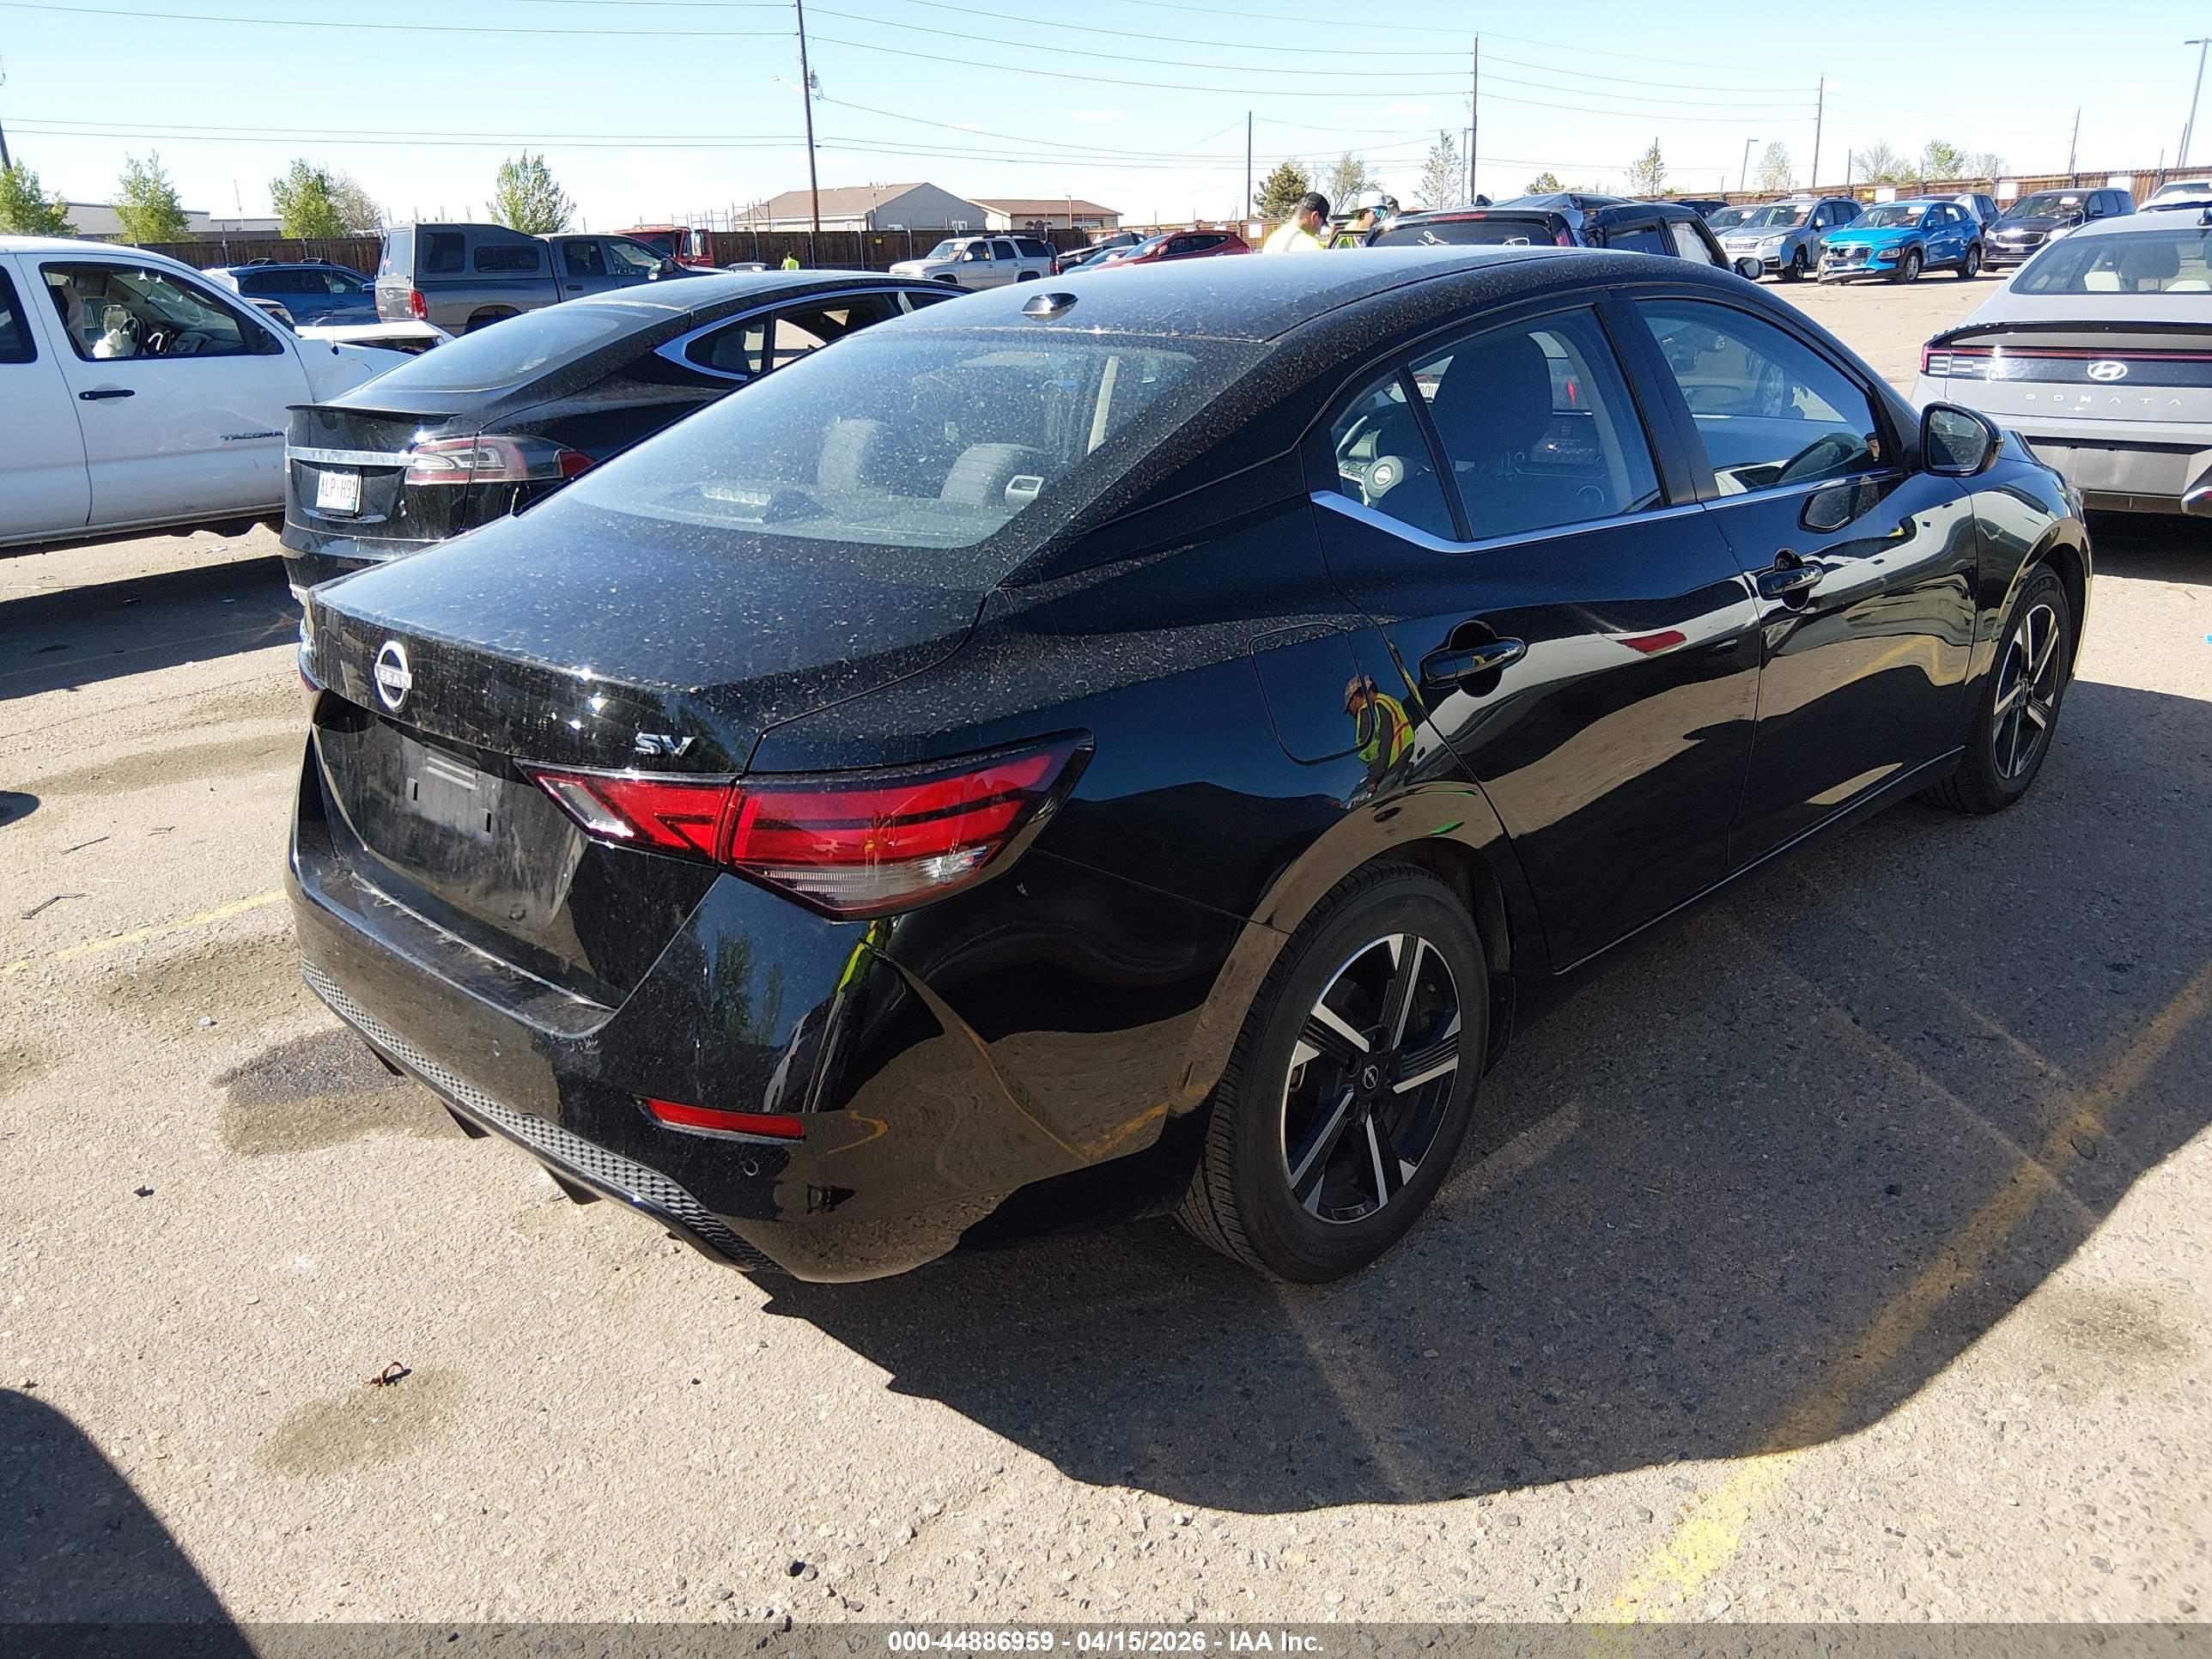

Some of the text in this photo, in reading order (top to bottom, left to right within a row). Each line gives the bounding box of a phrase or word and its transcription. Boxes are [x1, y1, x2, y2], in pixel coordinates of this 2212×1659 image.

[2025, 392, 2183, 407] SONATA
[220, 430, 285, 441] TACOMA
[376, 666, 410, 690] SSAN
[635, 732, 696, 757] SV
